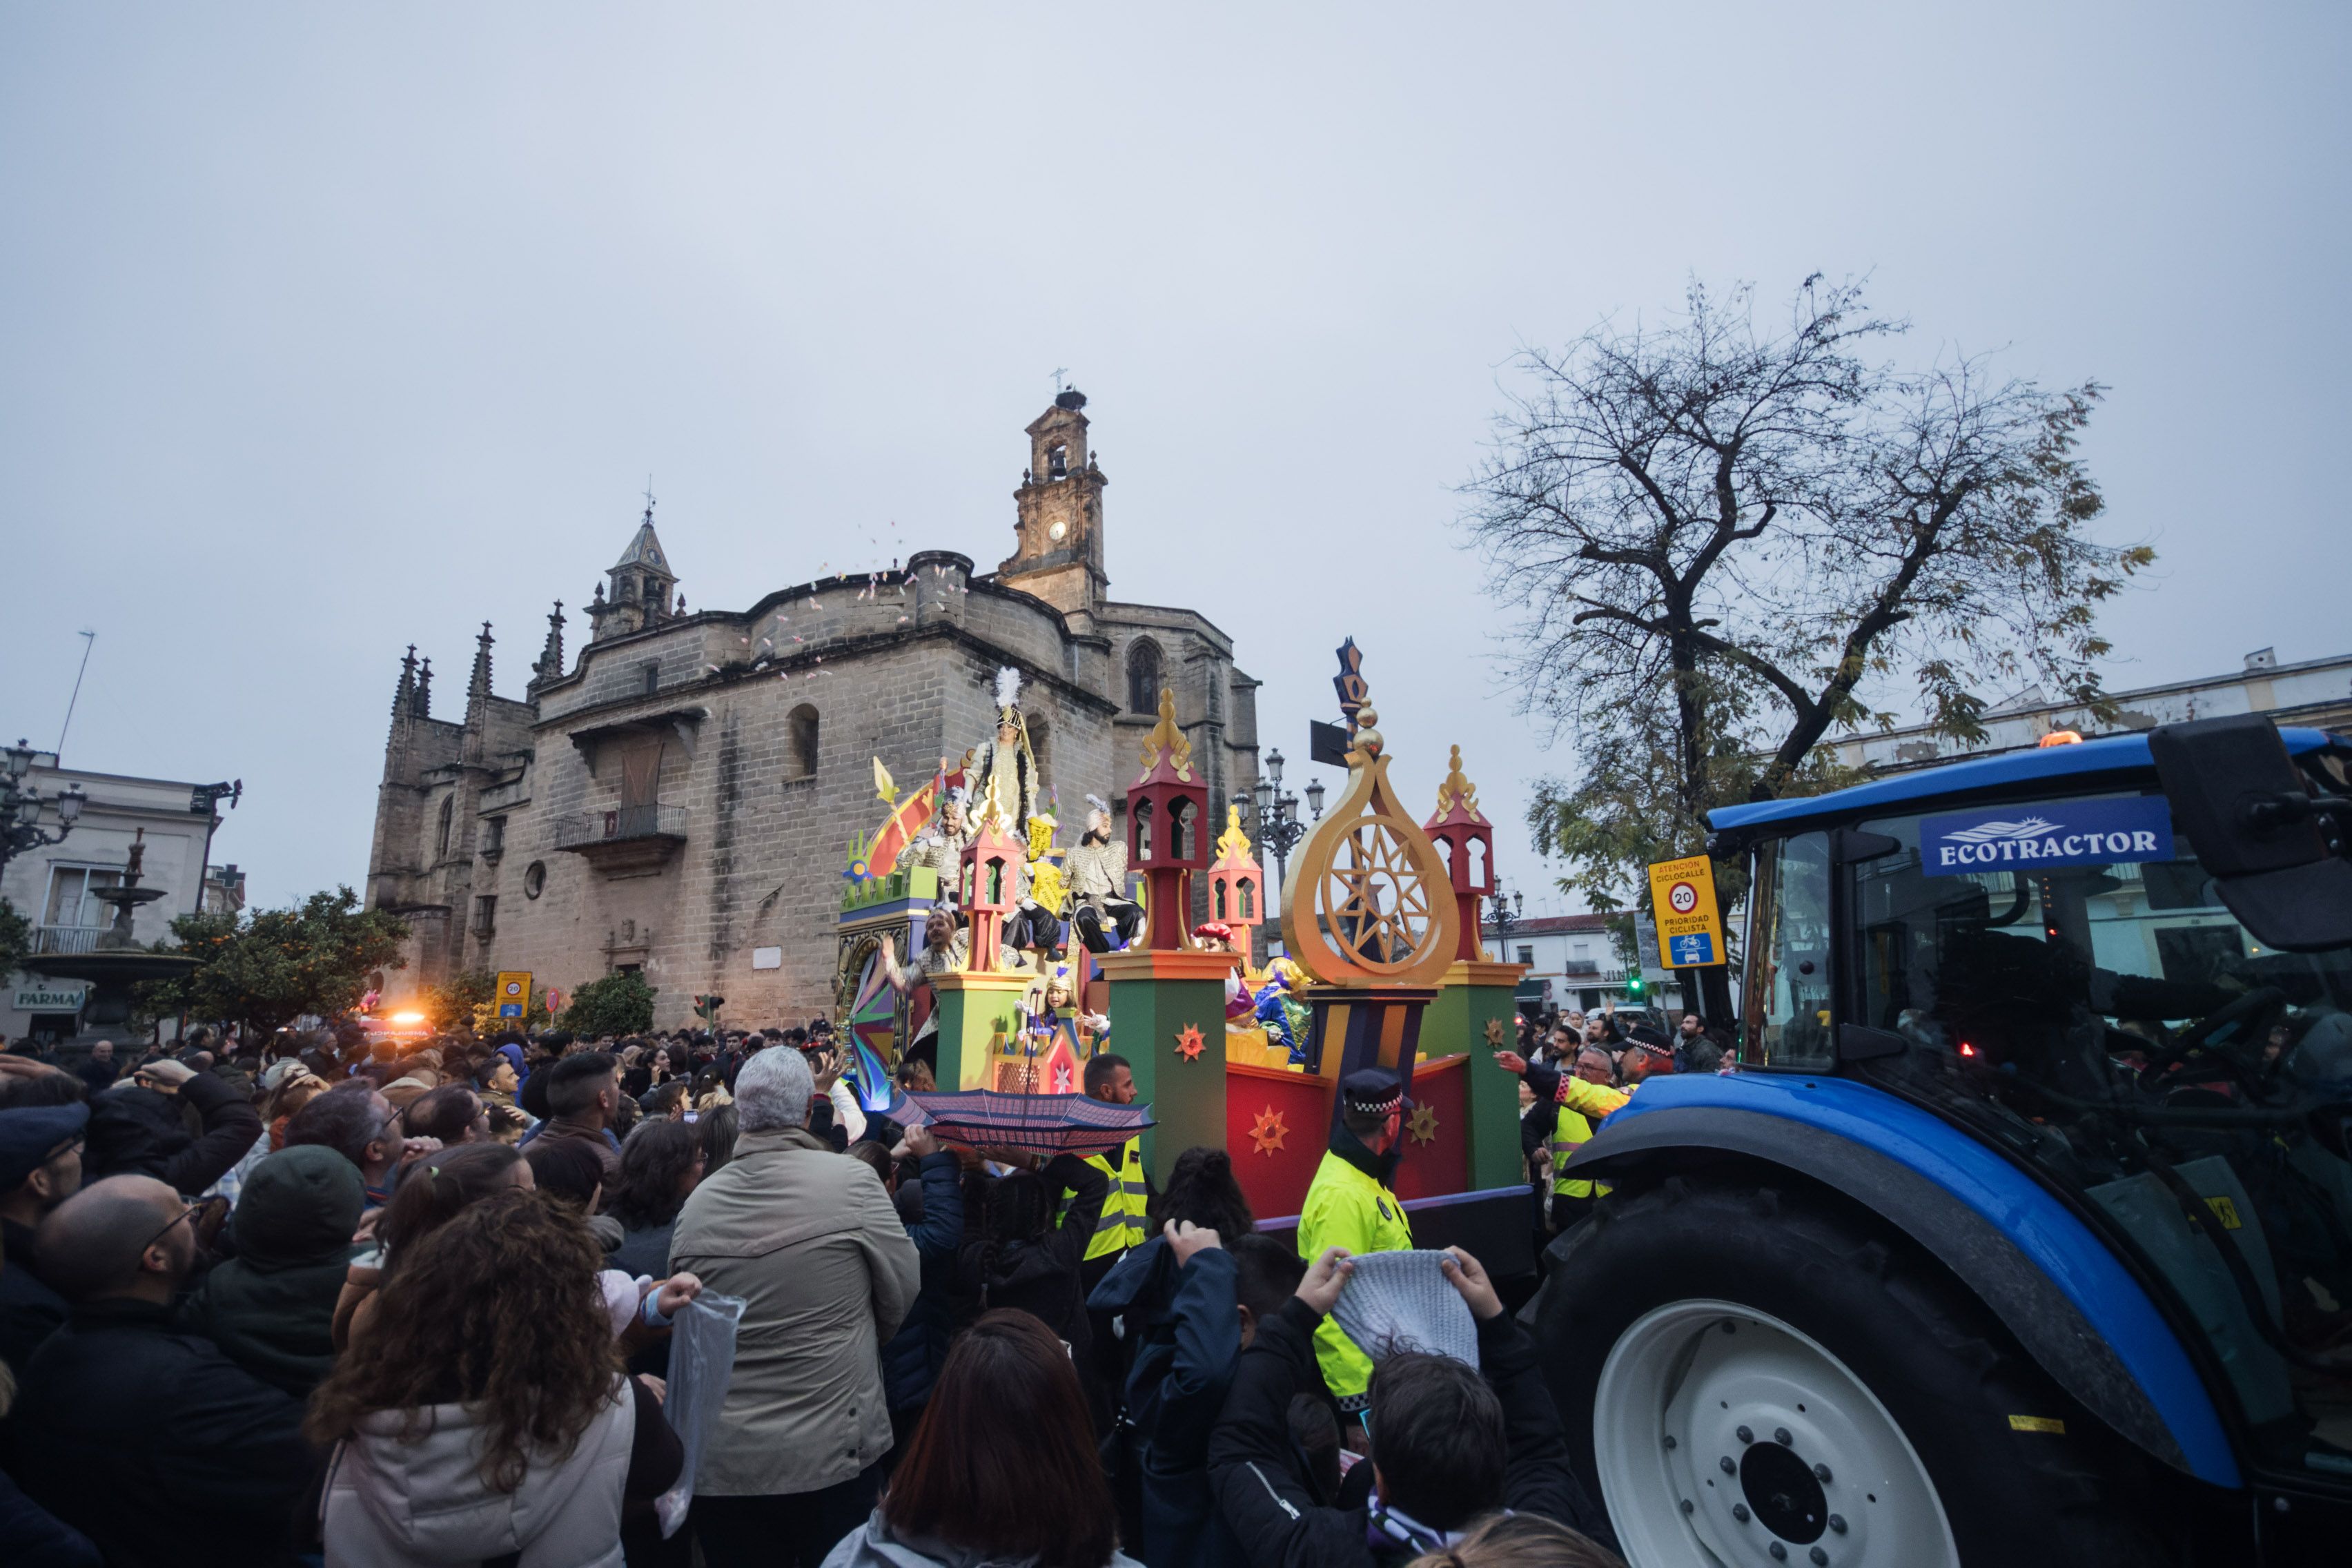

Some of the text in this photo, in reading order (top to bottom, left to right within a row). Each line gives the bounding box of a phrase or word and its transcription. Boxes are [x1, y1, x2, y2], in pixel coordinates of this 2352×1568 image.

[1940, 830, 2157, 866] ECOTRACTOR
[1656, 868, 1705, 883] CICLOCALLE
[1675, 892, 1692, 904] 20
[1665, 914, 1709, 926] PRIORIDAD
[1669, 924, 1707, 934] CICLISTA
[19, 993, 77, 1005] FARMA
